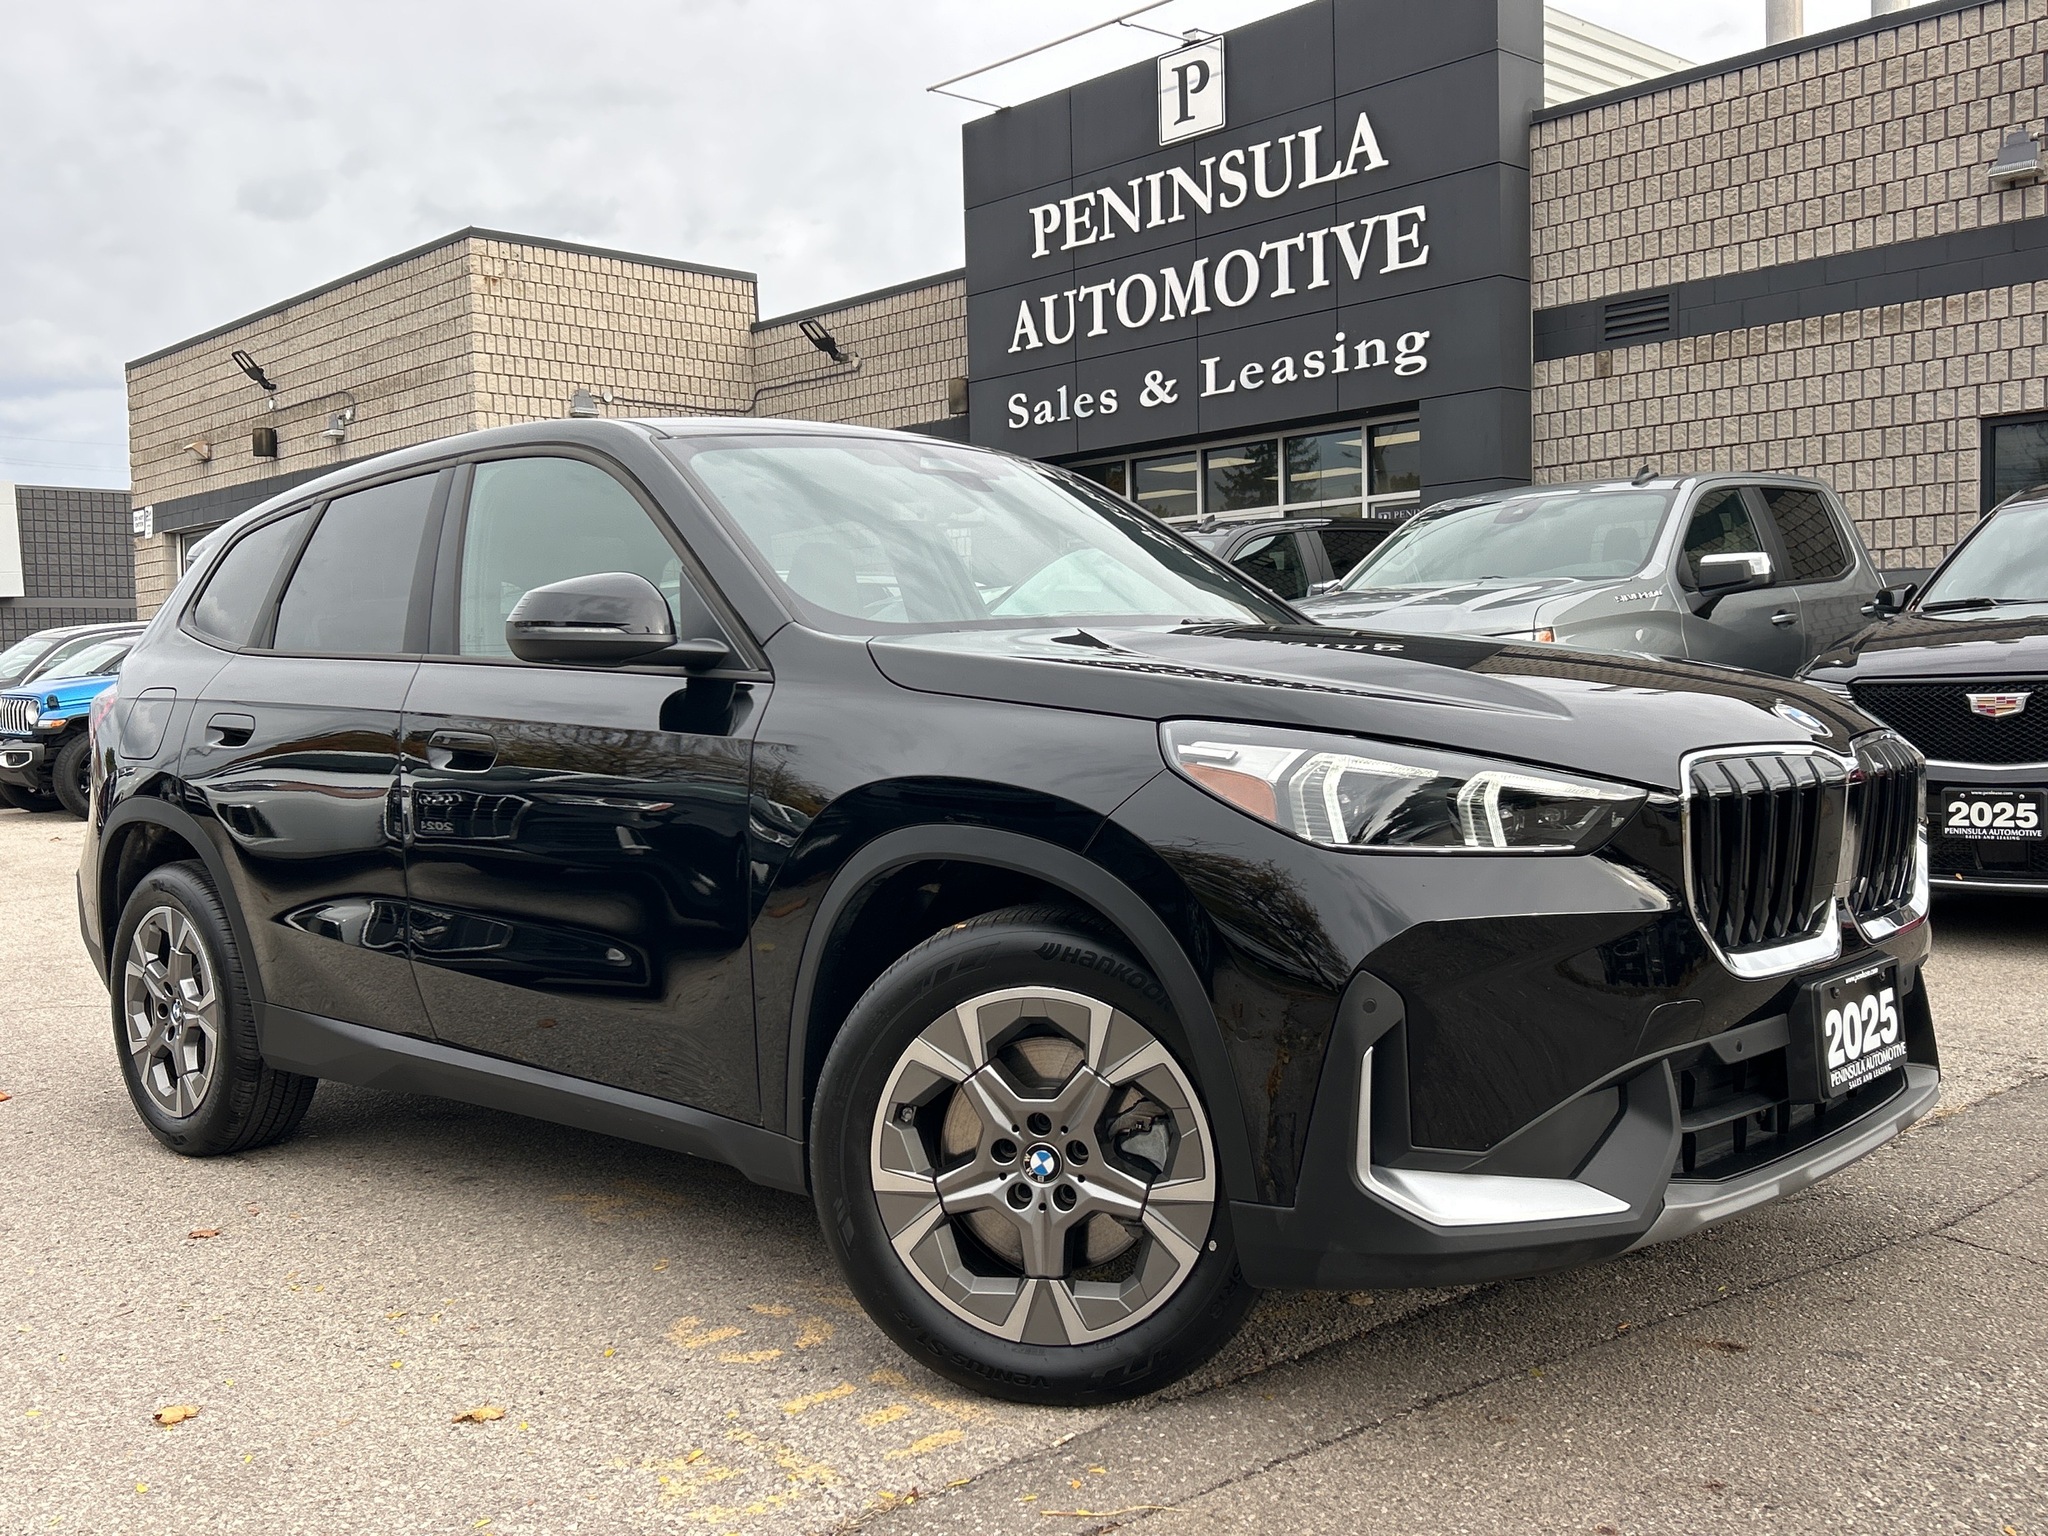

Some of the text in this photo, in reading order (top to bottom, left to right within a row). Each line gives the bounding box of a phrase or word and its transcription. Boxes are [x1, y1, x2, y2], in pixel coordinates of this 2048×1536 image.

[1171, 60, 1211, 126] P
[1029, 112, 1390, 259] PENINSULA
[1007, 205, 1430, 354] AUTOMOTIVE
[1007, 330, 1431, 430] Sales & Leasing
[1944, 827, 2043, 837] PENINSULA AUTOMOTIVE
[1948, 801, 2039, 829] 2025
[1825, 987, 1898, 1069] 2025
[1830, 1042, 1907, 1088] PENINSULA AUTOMOTIVE
[1848, 1063, 1892, 1090] SALES AND LEASING
